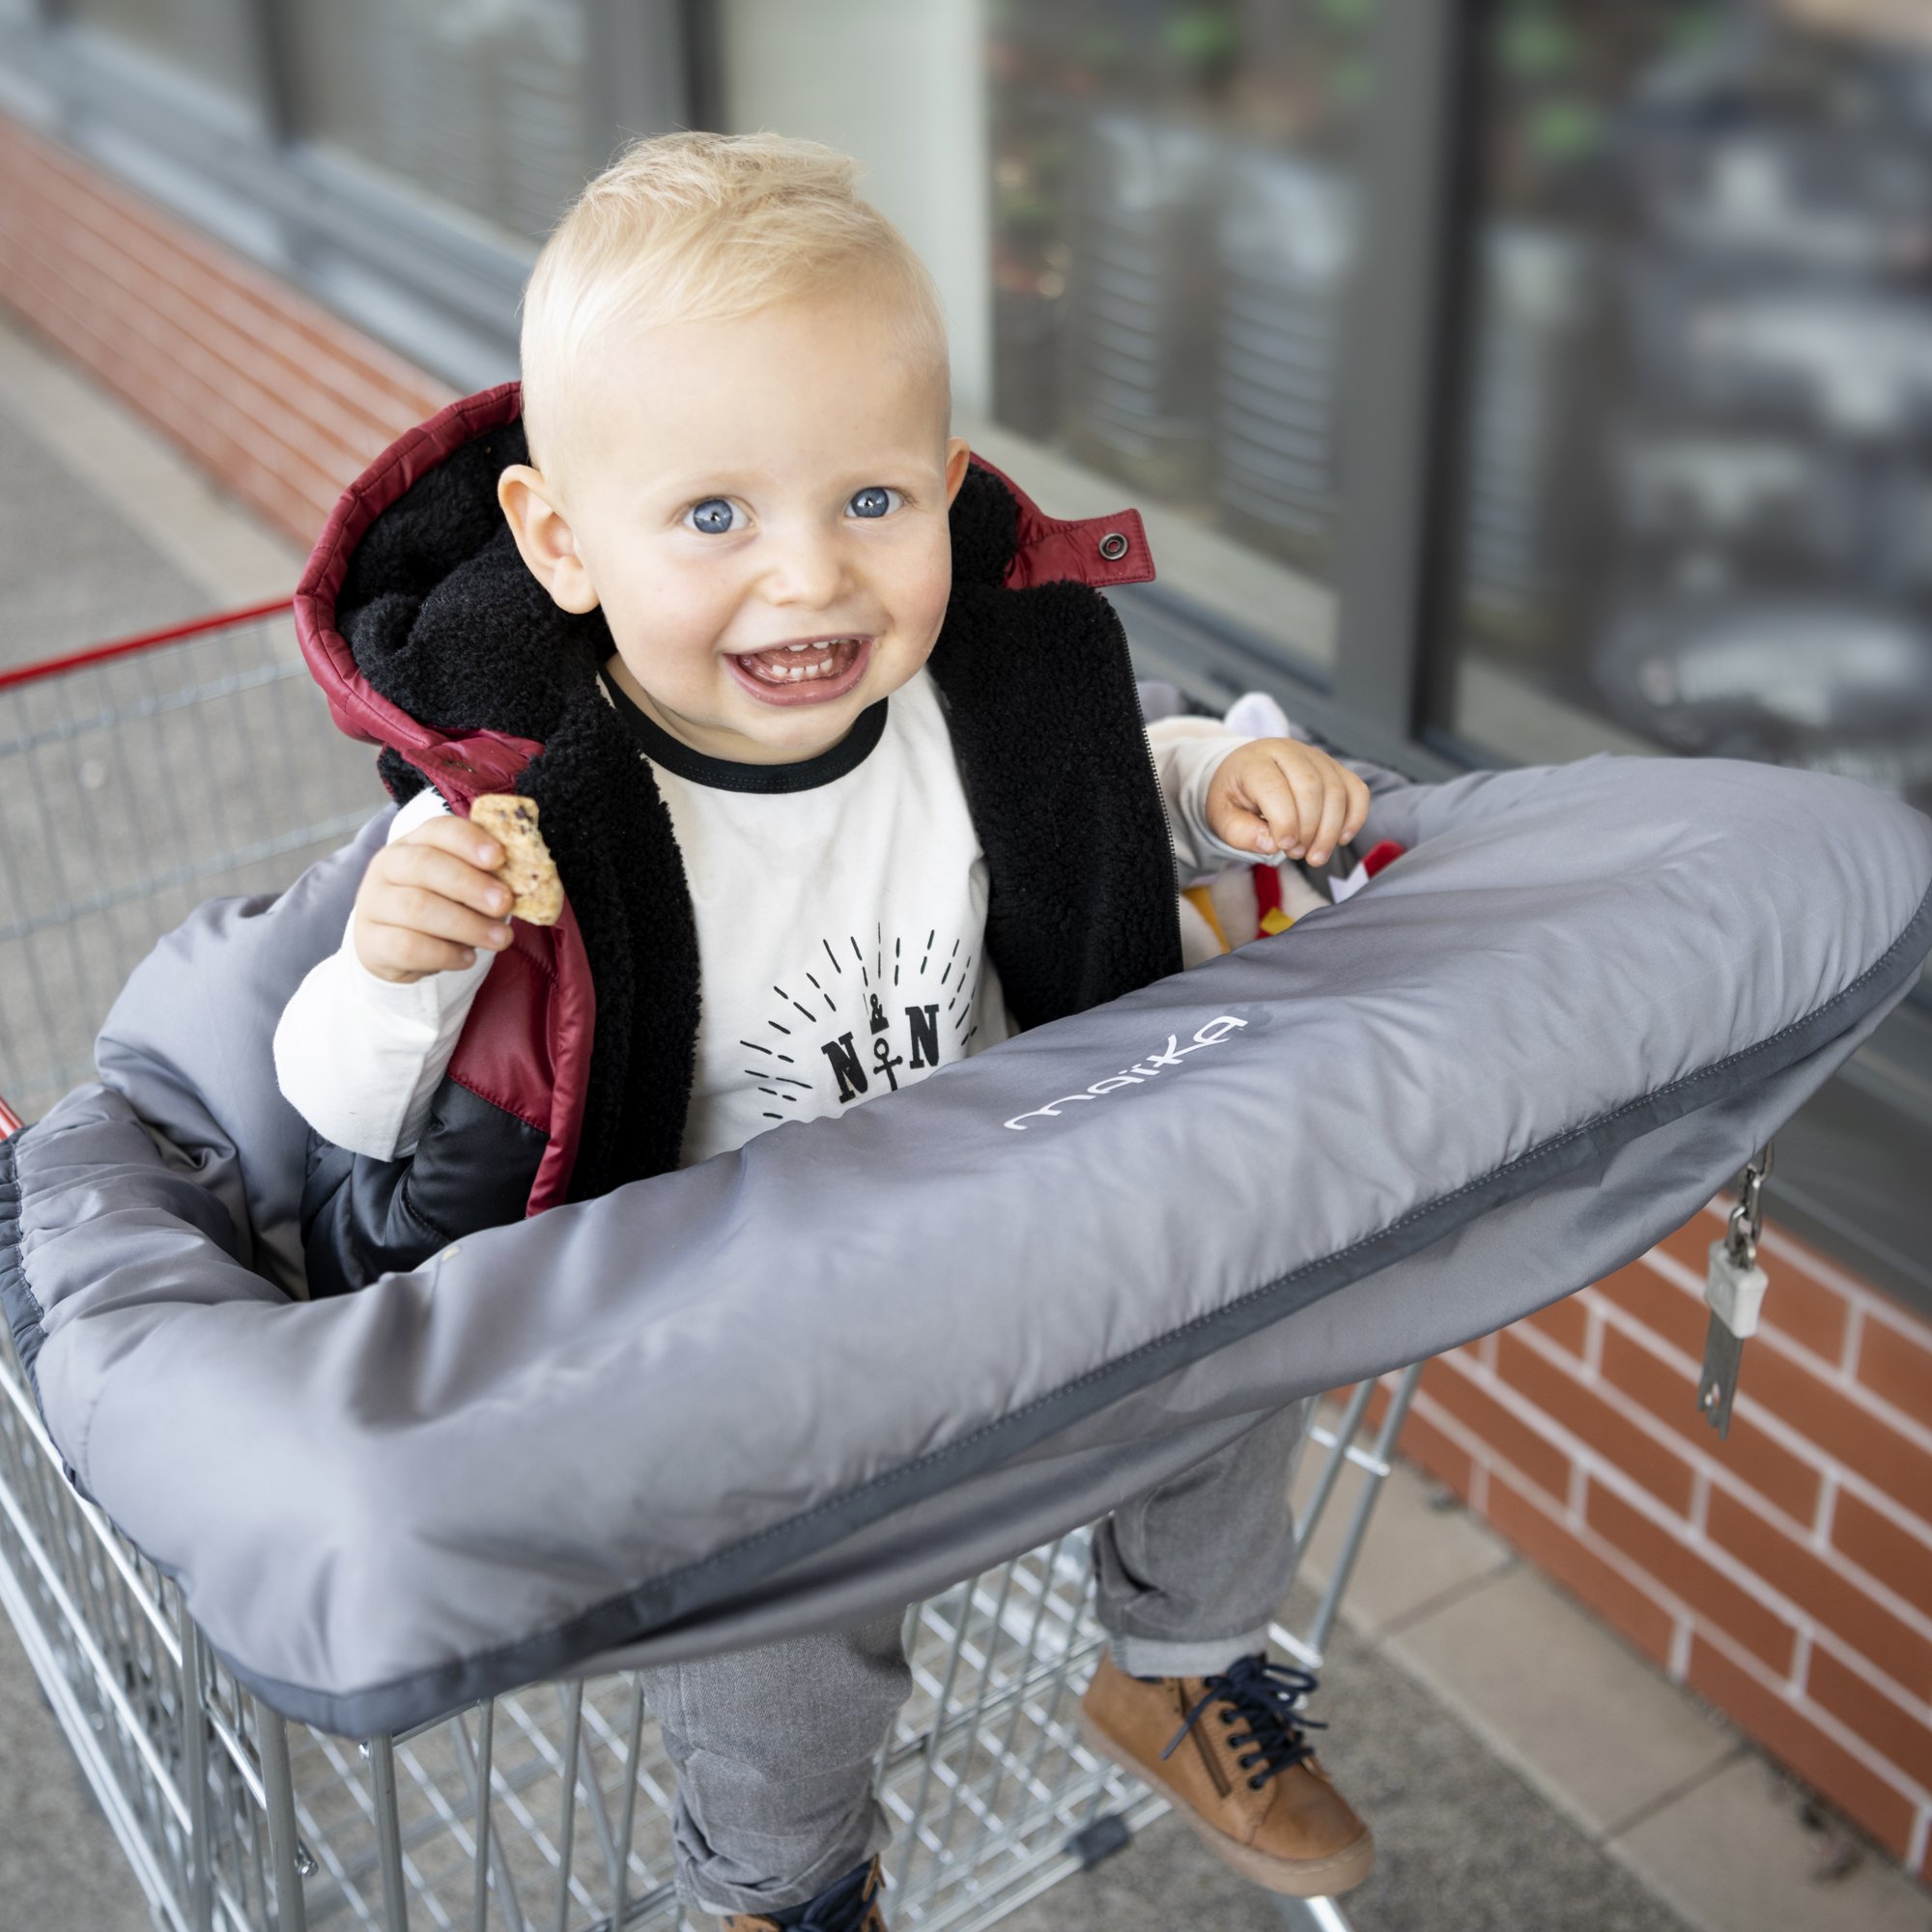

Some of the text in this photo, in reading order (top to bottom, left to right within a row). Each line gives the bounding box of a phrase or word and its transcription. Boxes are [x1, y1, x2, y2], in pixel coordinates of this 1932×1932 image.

[821, 993, 940, 1104] N & N
